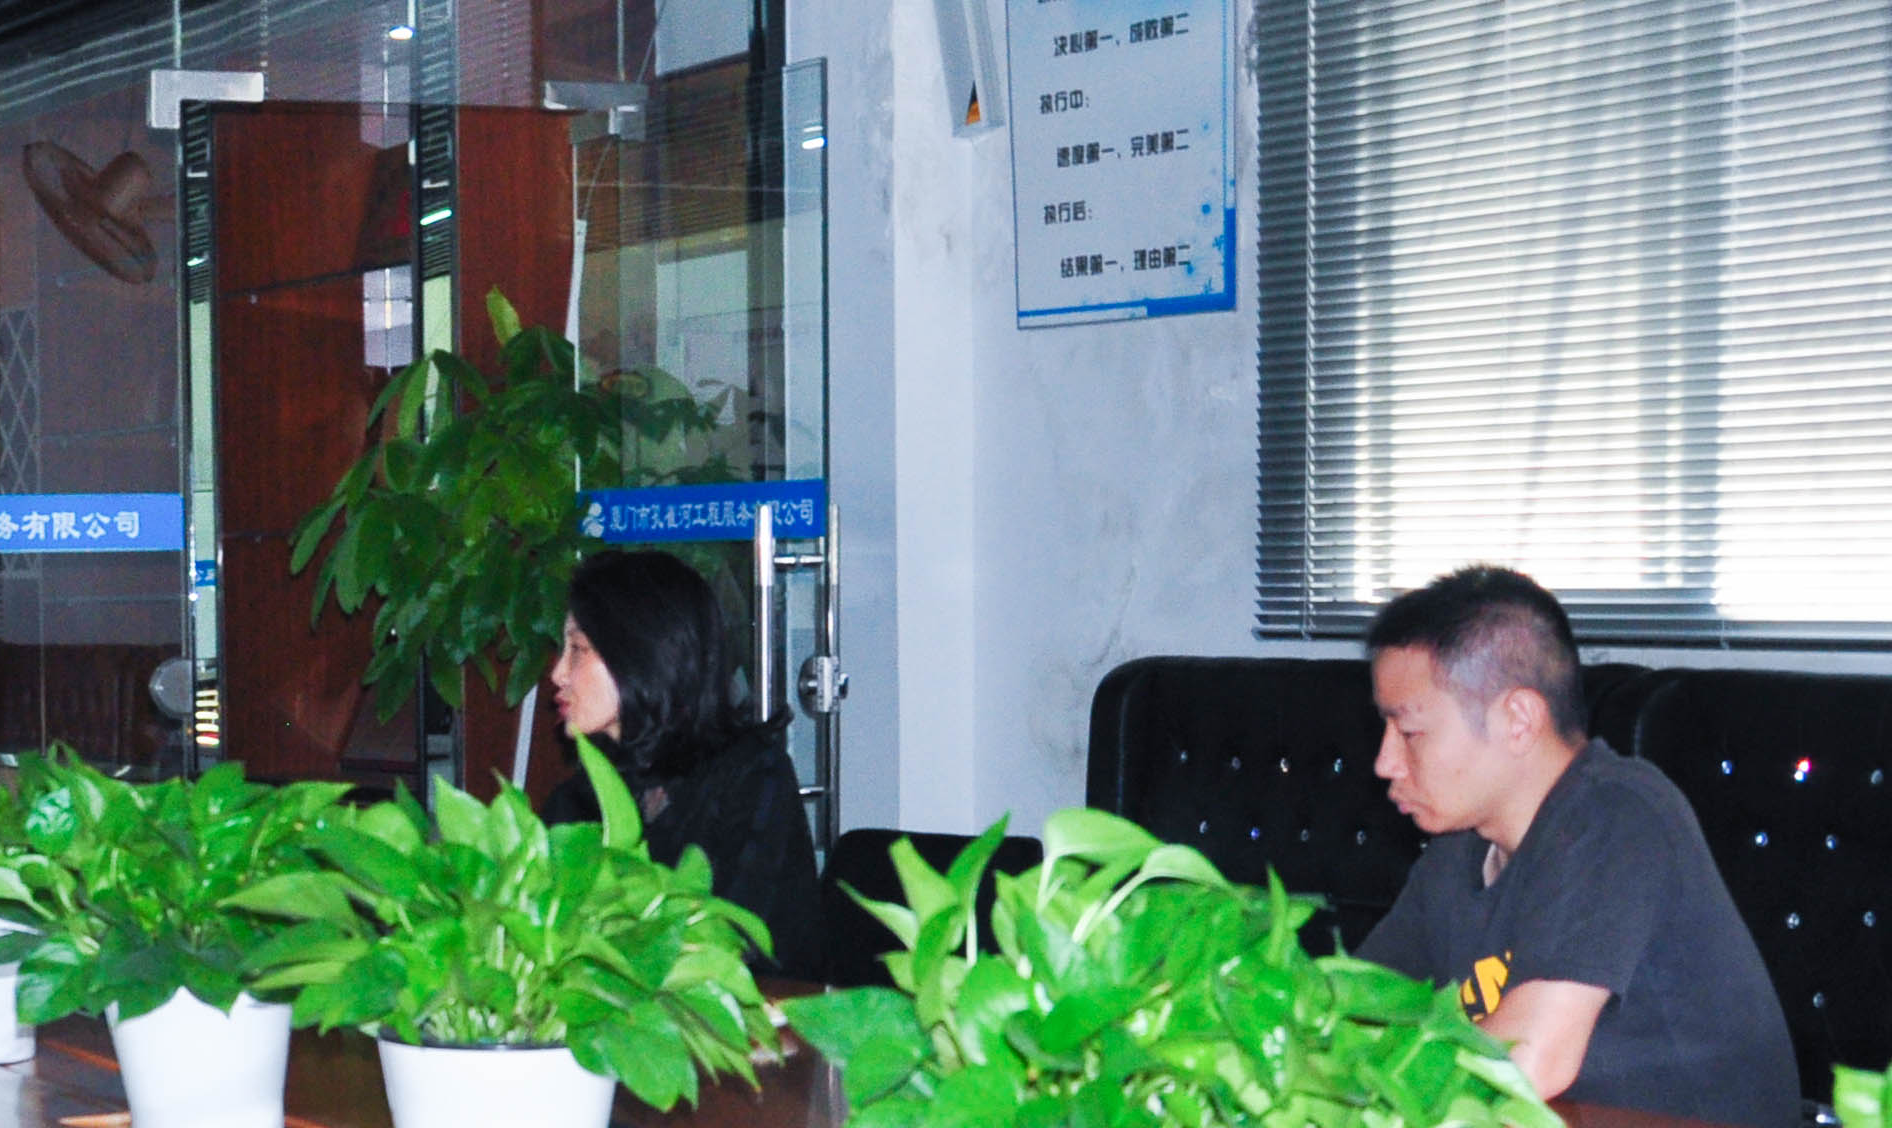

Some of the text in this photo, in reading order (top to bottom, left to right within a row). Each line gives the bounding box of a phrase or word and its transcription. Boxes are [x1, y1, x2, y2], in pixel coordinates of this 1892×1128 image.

[609, 498, 814, 531] 厦门市孔雀河工程服务限公司
